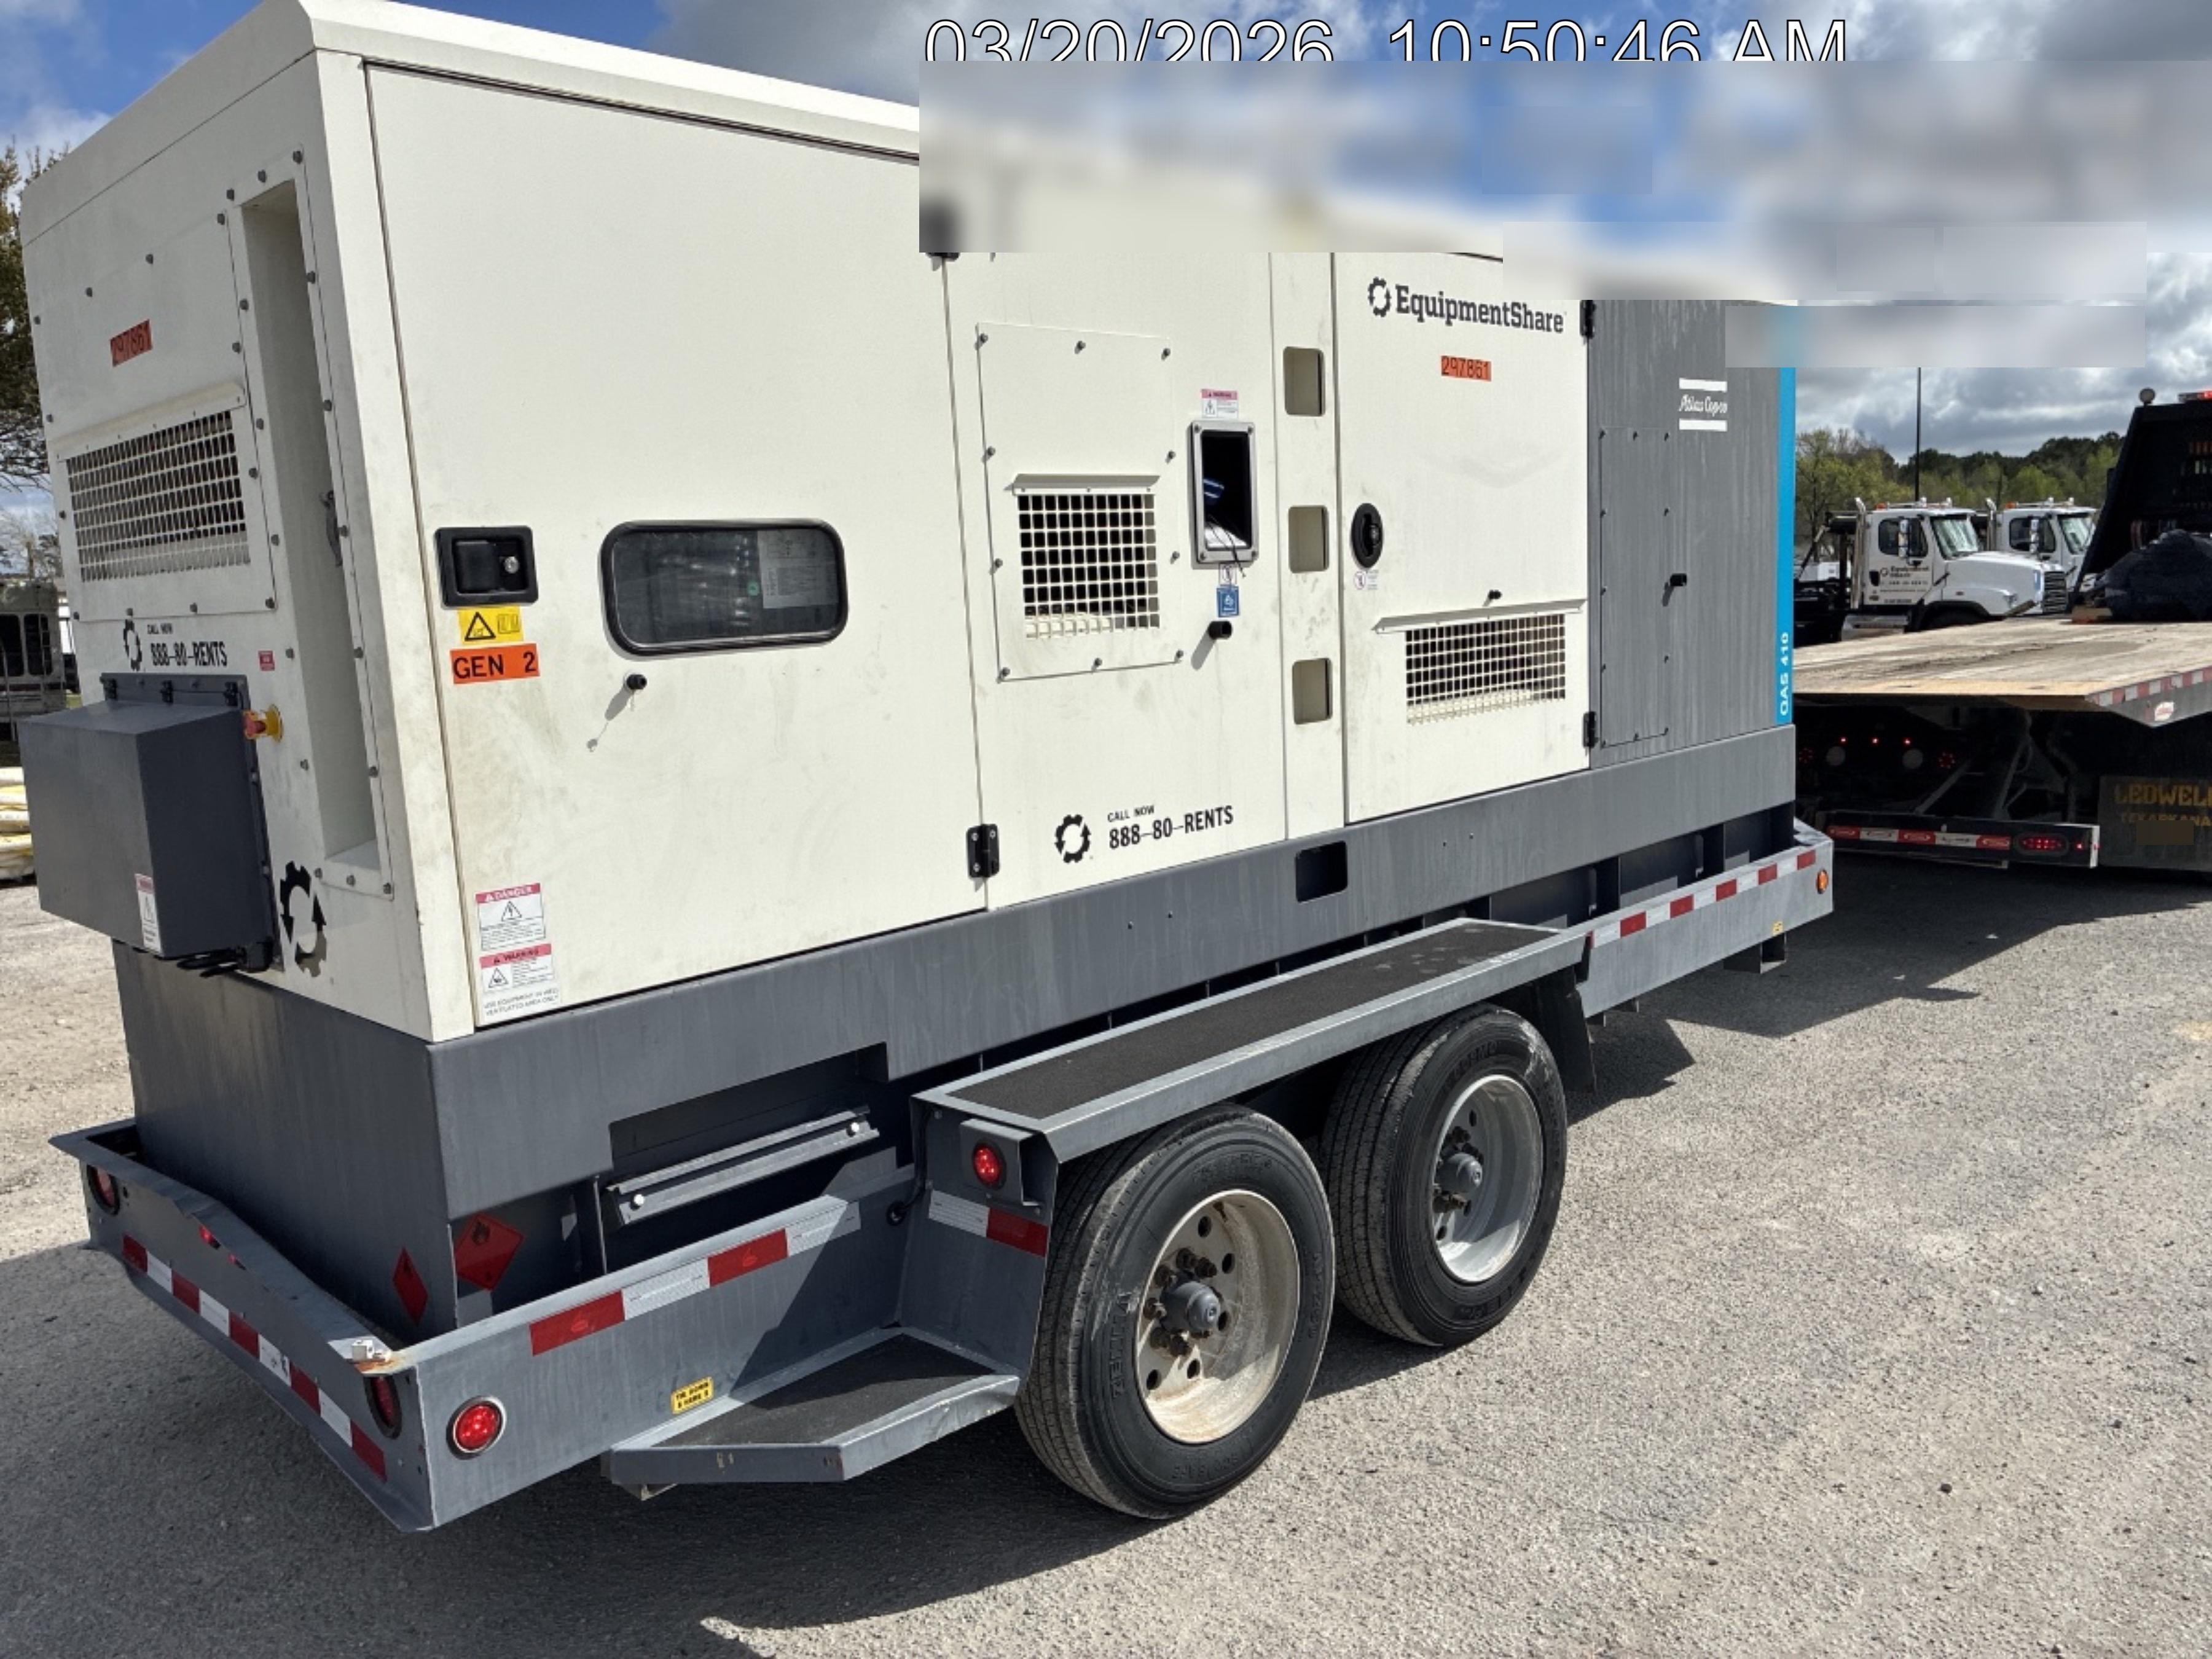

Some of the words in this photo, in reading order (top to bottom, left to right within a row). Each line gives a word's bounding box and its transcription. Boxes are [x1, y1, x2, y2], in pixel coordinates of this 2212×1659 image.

[1395, 284, 1564, 333] EquipmentShare
[151, 641, 227, 667] 888-80-RENTS
[453, 654, 504, 679] GEN
[524, 651, 536, 673] 2
[1780, 632, 1789, 666] 410
[1780, 672, 1789, 716] QAS
[1107, 809, 1130, 822] CALL
[1134, 805, 1155, 817] NOW
[1109, 805, 1234, 849] 888-80-RENTS
